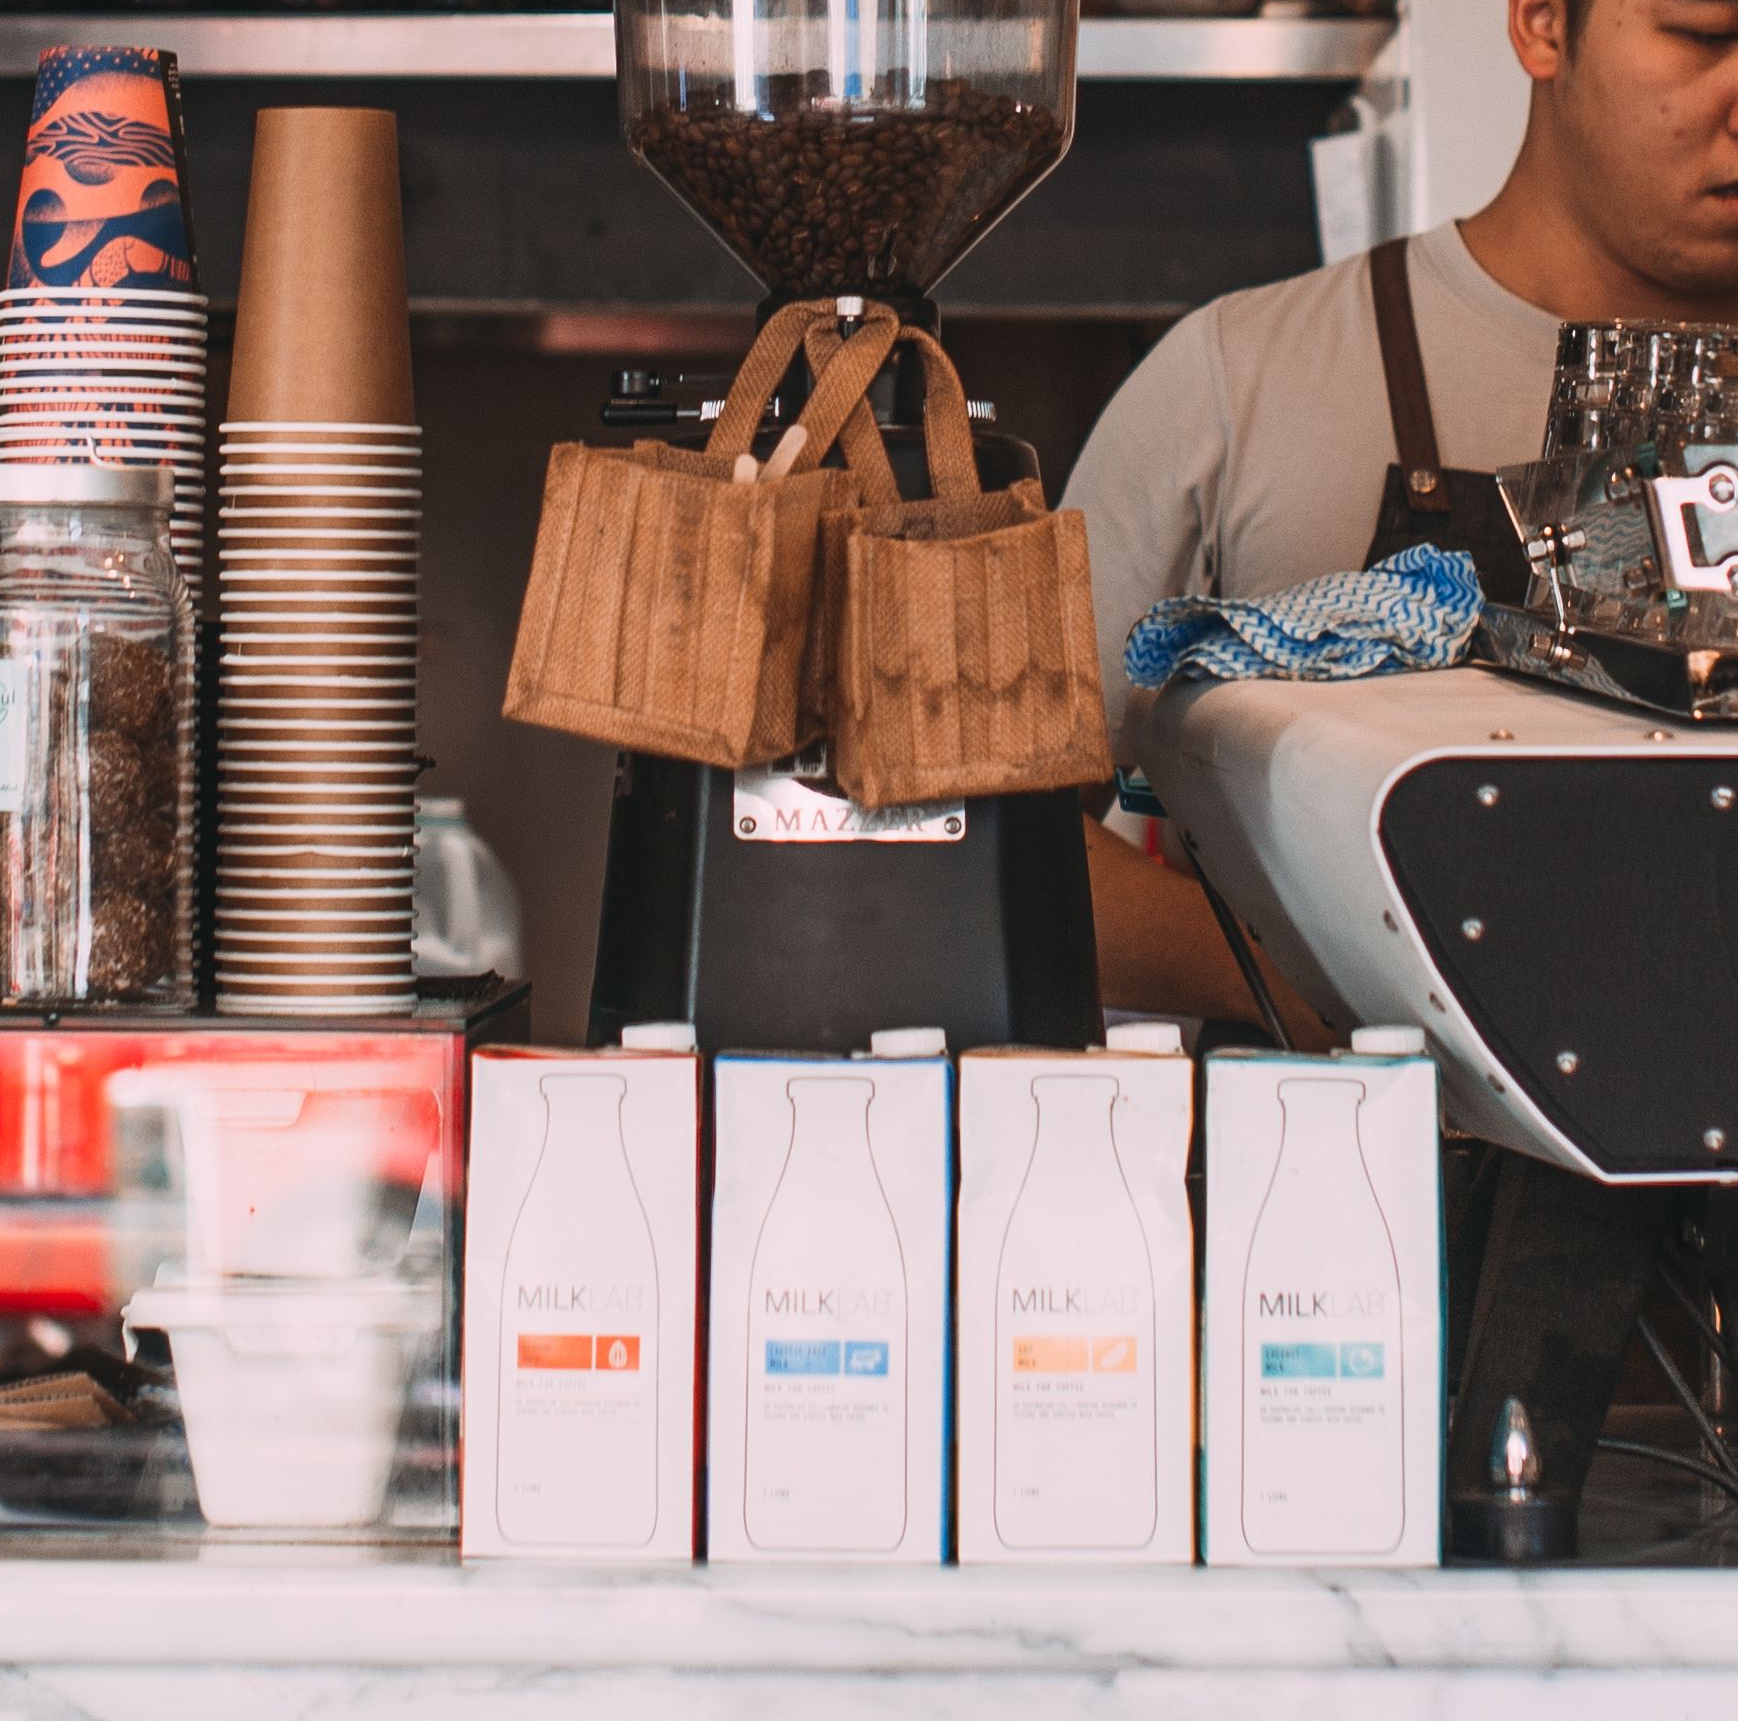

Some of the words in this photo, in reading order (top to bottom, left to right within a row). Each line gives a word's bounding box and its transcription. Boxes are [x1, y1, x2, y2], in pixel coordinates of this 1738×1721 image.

[774, 806, 926, 832] MAZZER
[517, 1284, 644, 1311] MILKLAB
[765, 1289, 892, 1316] MILKLAB
[1013, 1287, 1140, 1314] MILKLAB
[1259, 1291, 1387, 1319] MILKLAB
